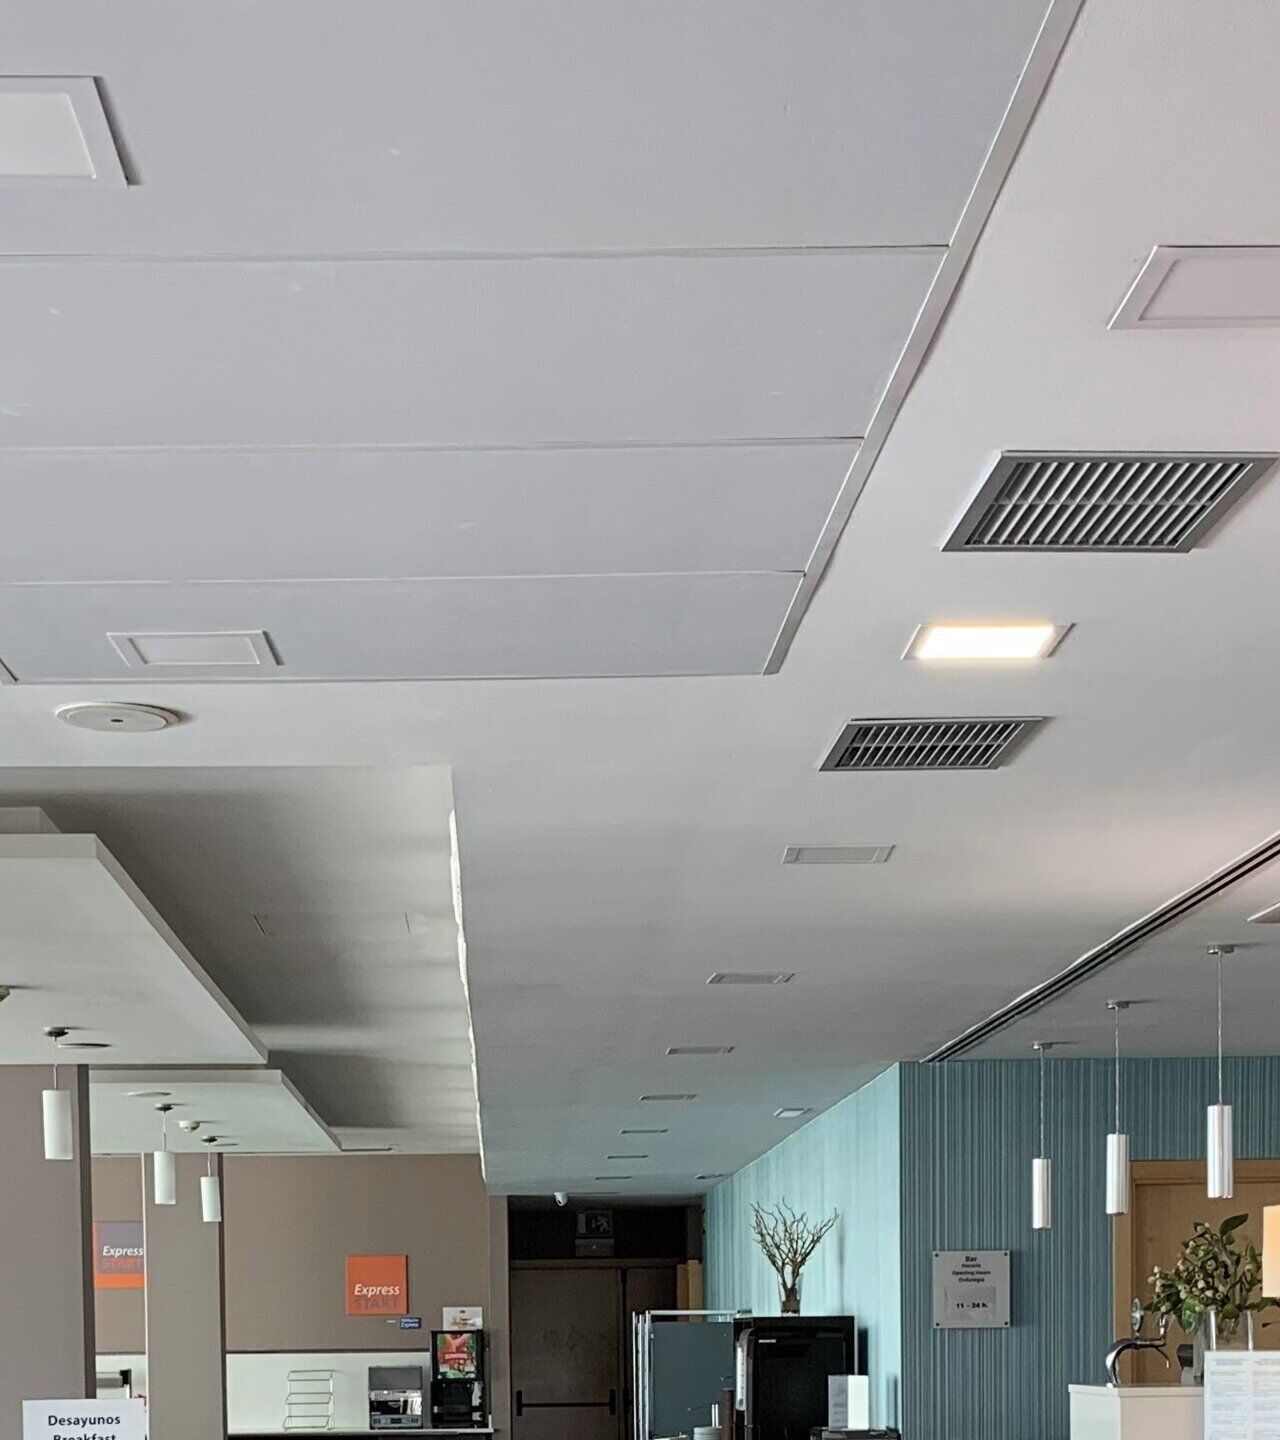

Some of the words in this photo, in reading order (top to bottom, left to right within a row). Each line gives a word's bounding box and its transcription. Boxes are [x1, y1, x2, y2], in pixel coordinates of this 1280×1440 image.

[103, 1245, 144, 1258] Express
[354, 1283, 400, 1298] Express
[48, 1415, 121, 1428] Desayunos
